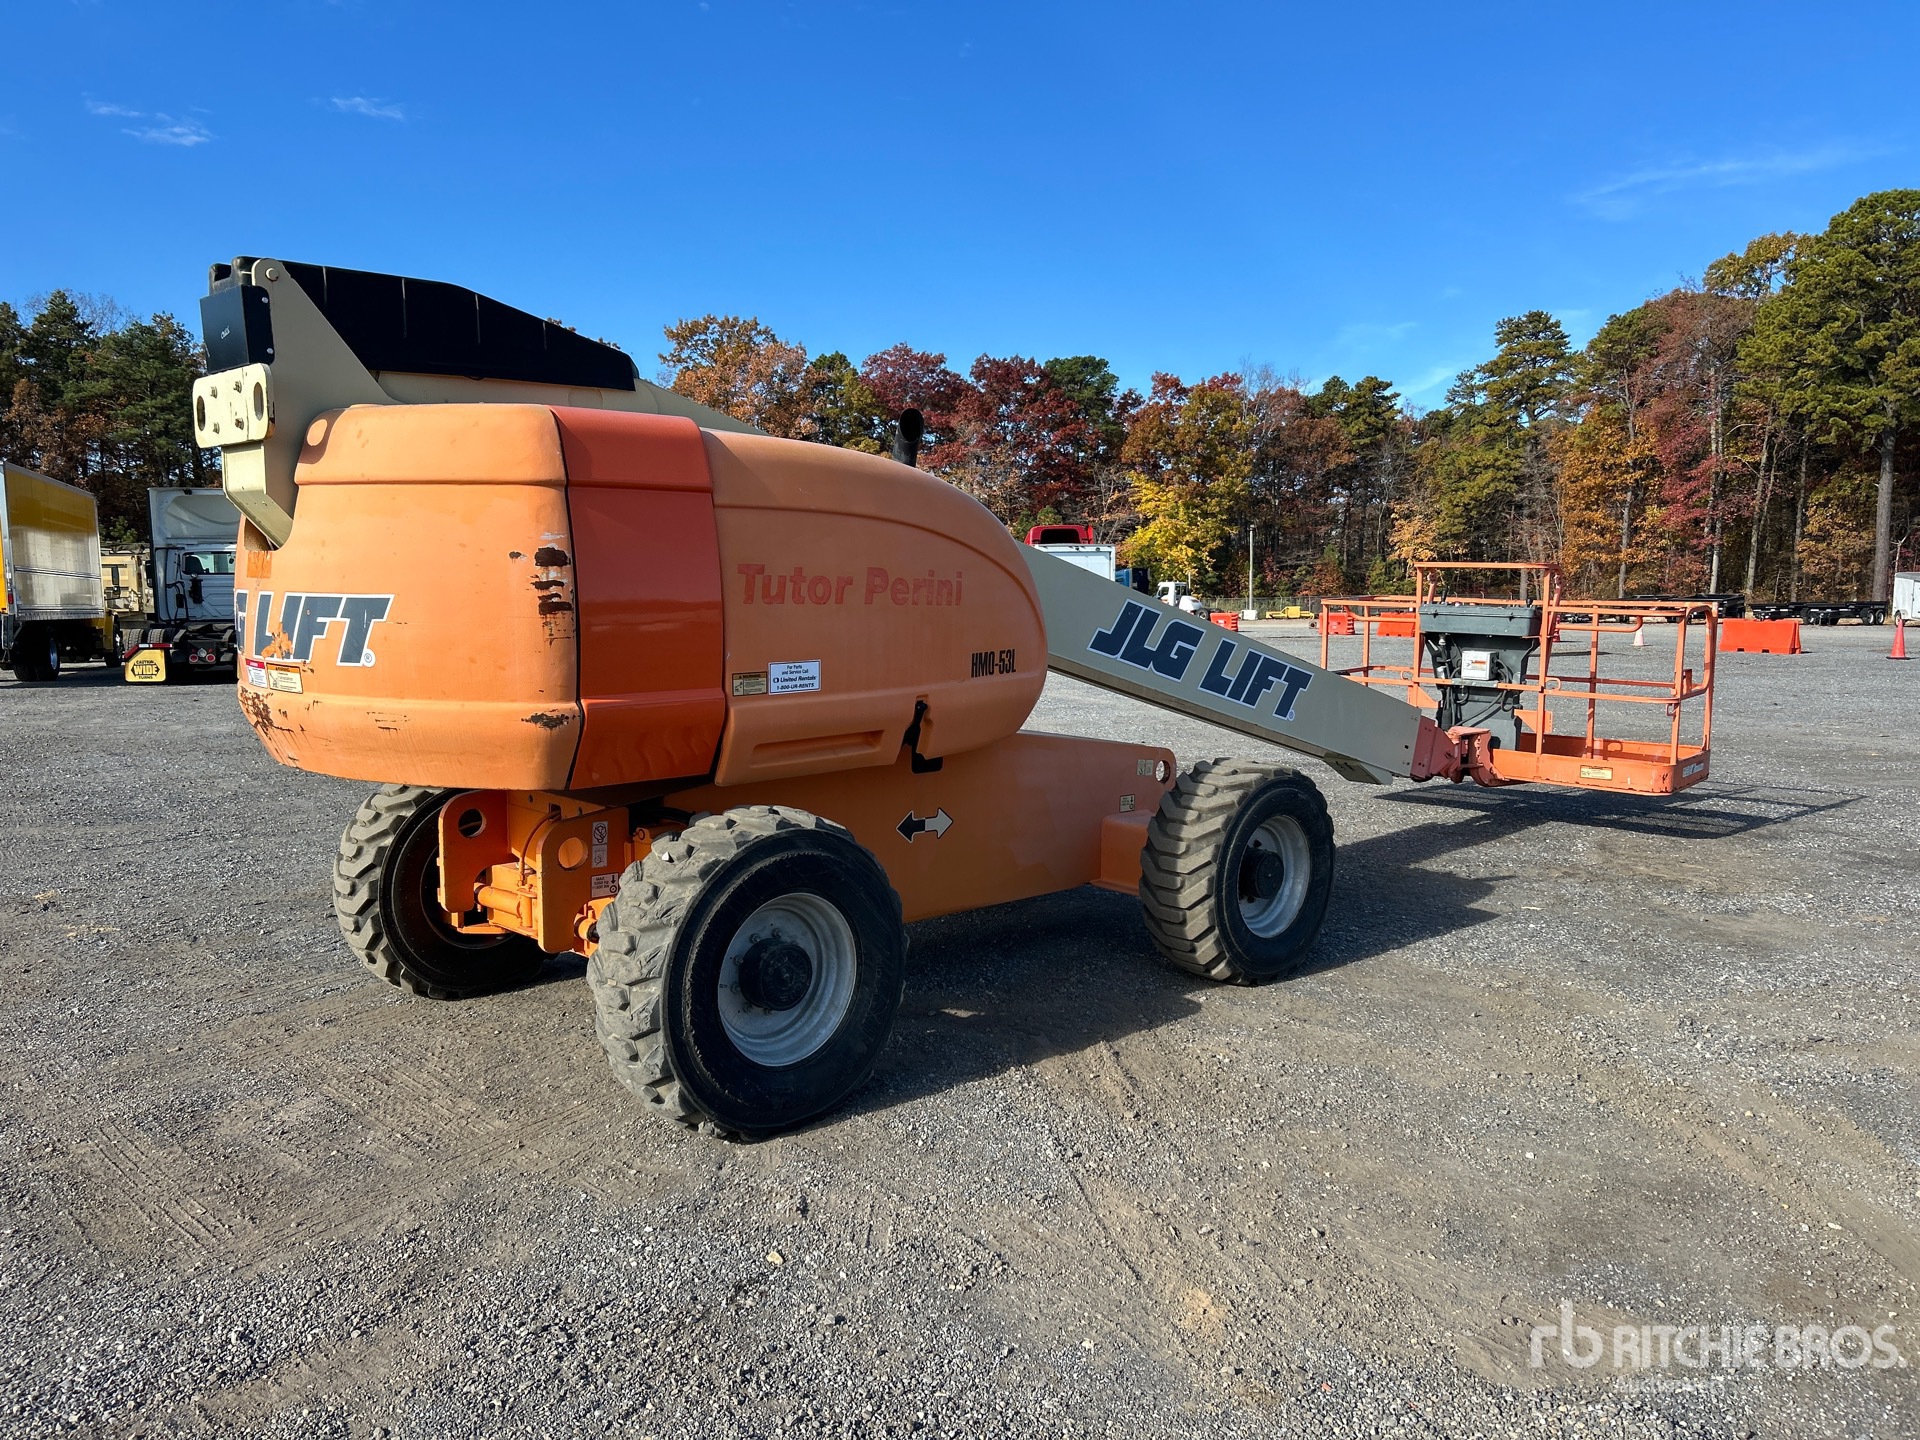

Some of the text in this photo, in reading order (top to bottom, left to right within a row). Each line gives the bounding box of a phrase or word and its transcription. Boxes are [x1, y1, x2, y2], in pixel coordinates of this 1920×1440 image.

[736, 563, 963, 606] Tutor Perini
[253, 590, 395, 667] LIFT
[134, 665, 157, 674] WIDE
[1087, 599, 1314, 720] JLG LIFT
